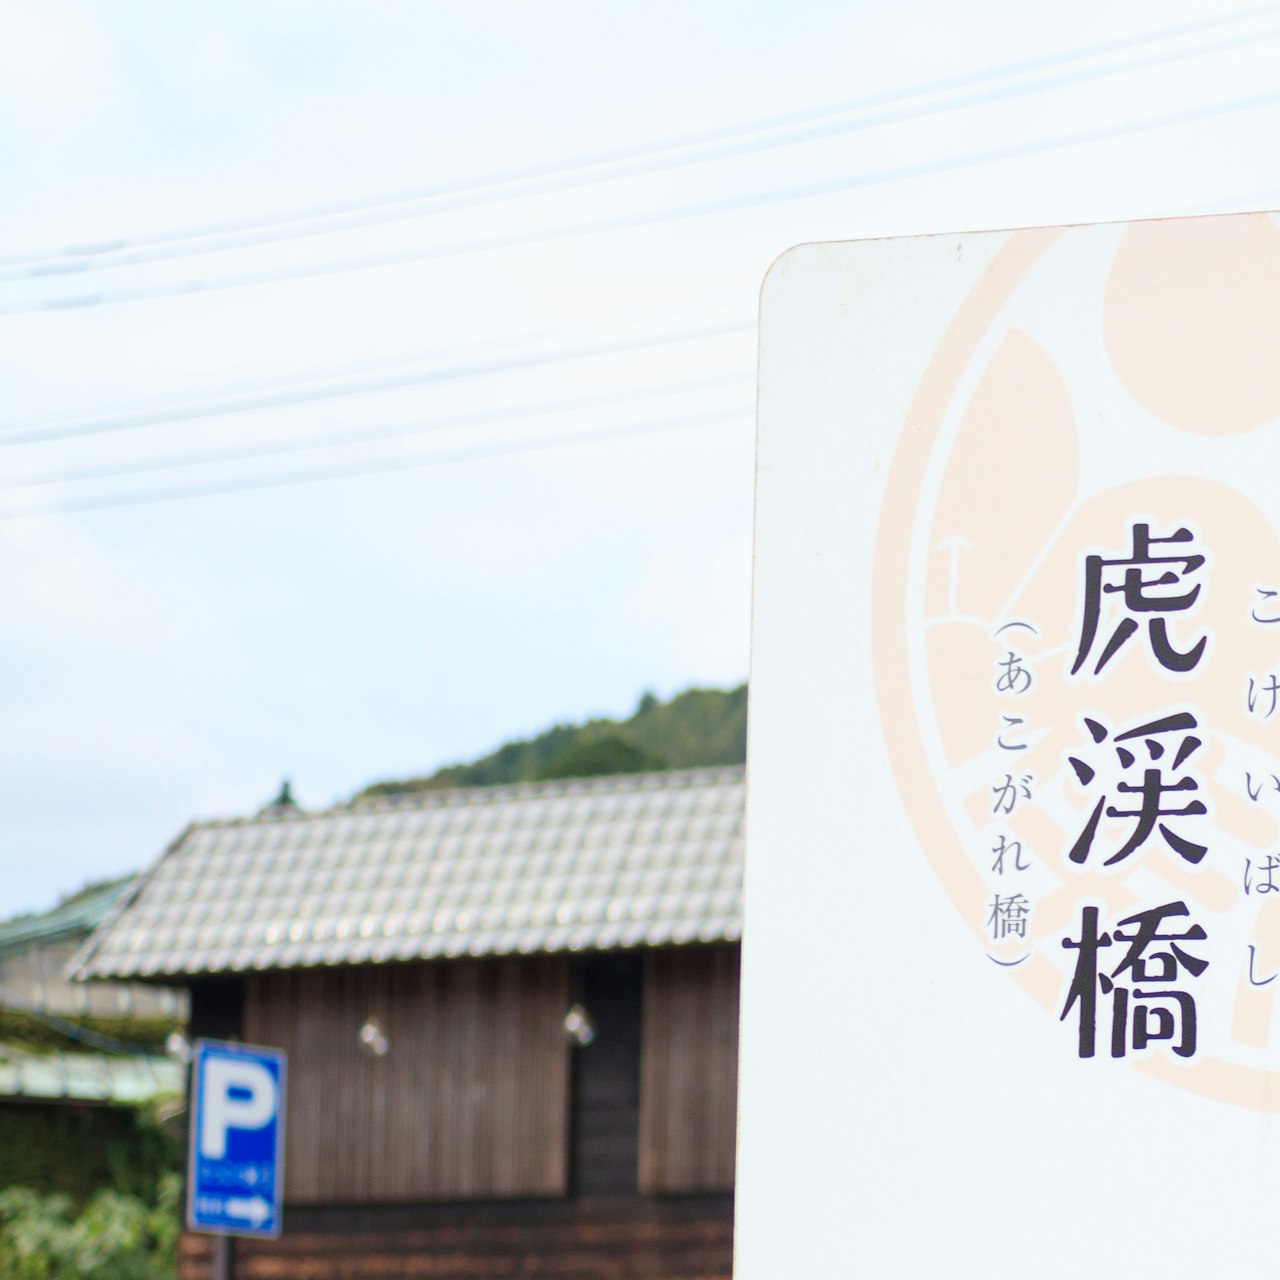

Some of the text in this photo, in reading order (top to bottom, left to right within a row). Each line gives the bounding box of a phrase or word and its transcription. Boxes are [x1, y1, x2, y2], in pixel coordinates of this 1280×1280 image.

[986, 621, 1038, 967] （あこがれ橋）
[1060, 522, 1210, 1059] 虎渓橋
[201, 1056, 277, 1160] P
